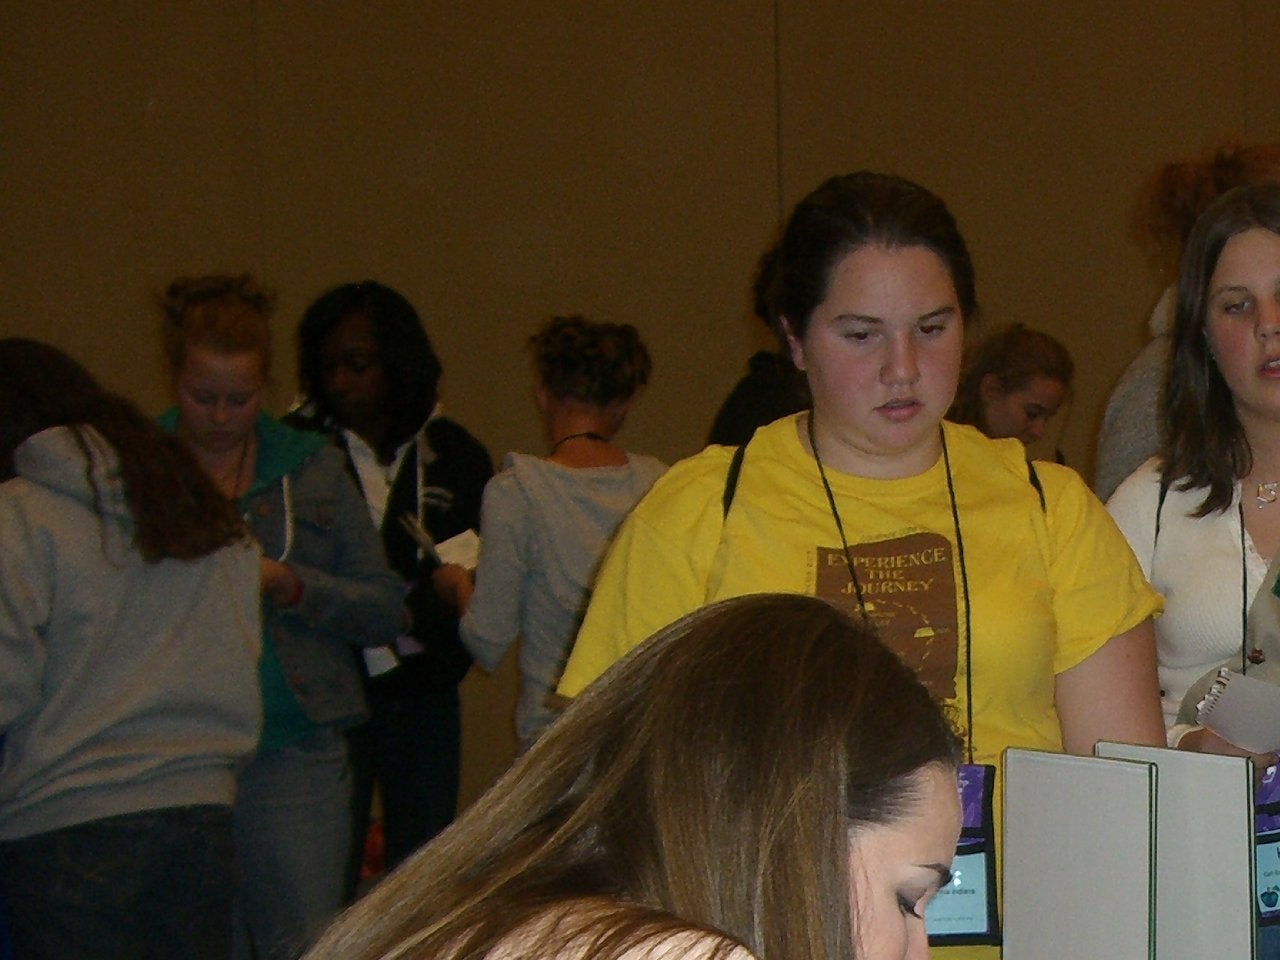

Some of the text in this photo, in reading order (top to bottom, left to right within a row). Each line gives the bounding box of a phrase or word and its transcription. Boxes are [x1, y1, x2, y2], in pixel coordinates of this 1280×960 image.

[827, 547, 947, 568] EXPERIENCE
[865, 569, 904, 580] THE
[841, 578, 934, 595] JOURNEY
